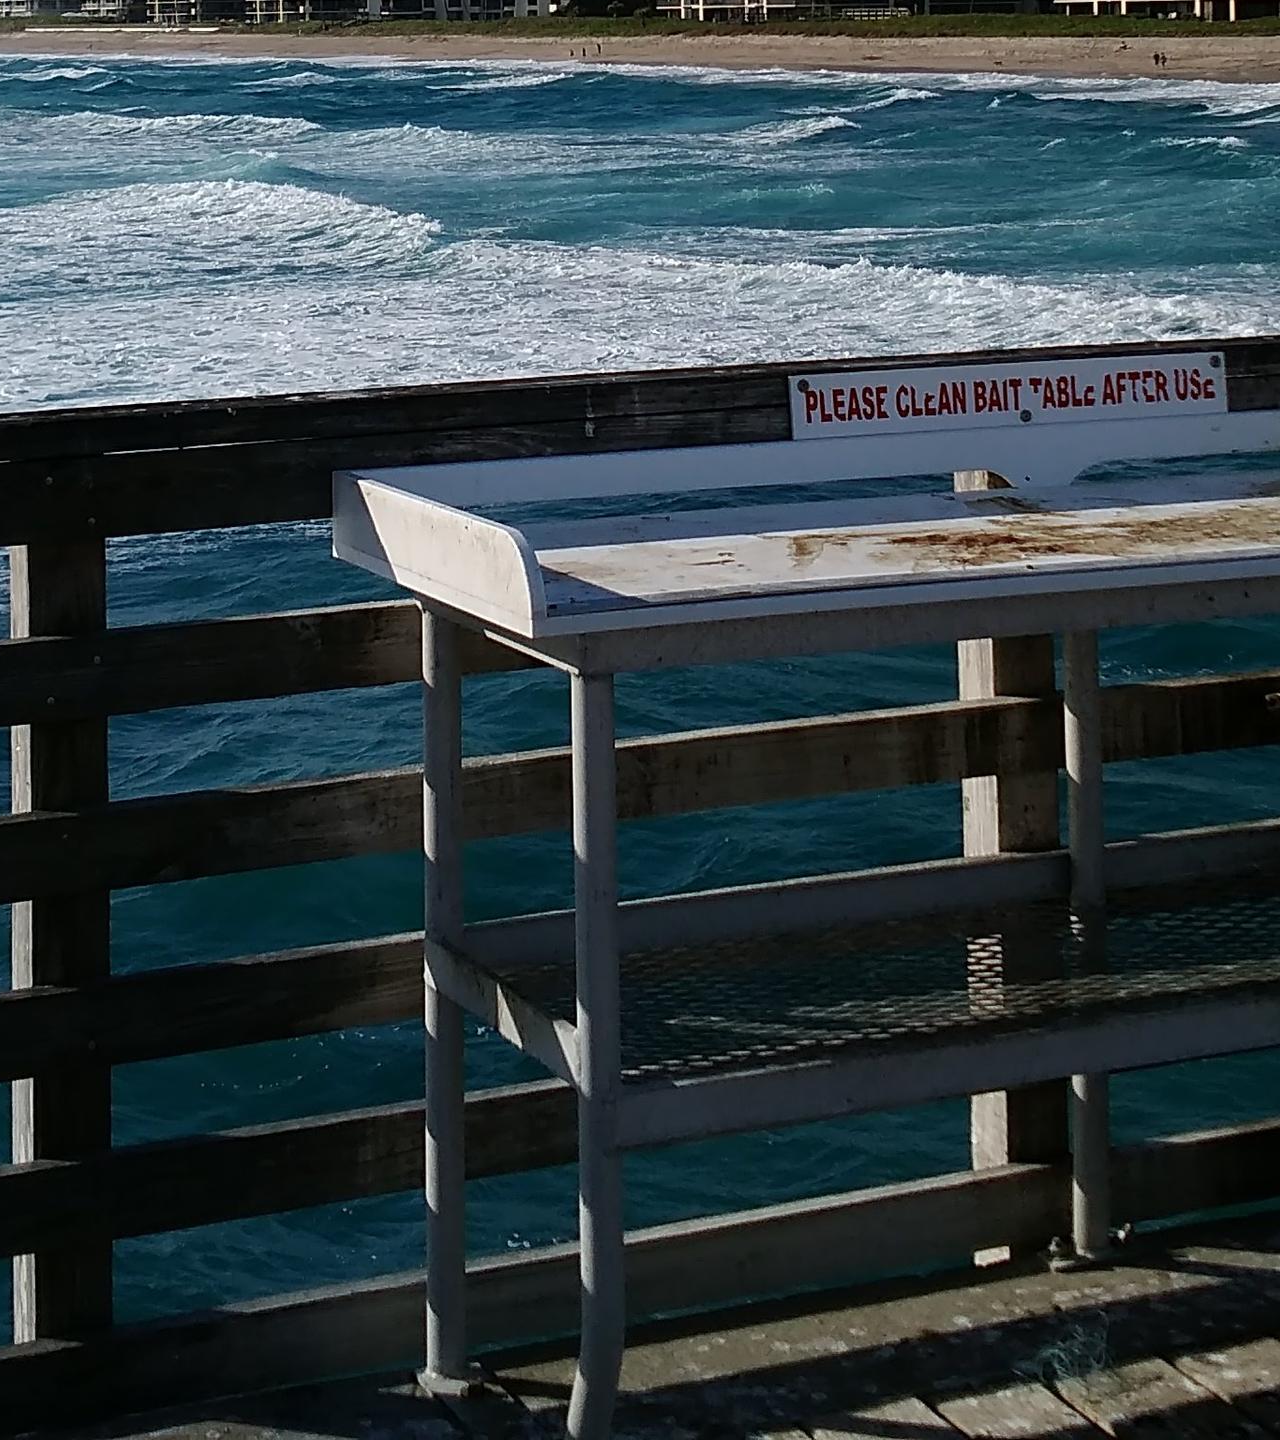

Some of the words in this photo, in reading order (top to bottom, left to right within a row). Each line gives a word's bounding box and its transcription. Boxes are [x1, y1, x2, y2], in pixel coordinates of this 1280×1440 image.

[805, 386, 889, 423] PLEASE
[896, 382, 967, 418] CLEAN
[973, 378, 1022, 412] BAIT
[1102, 370, 1169, 405] AFTER
[1174, 368, 1216, 401] USE
